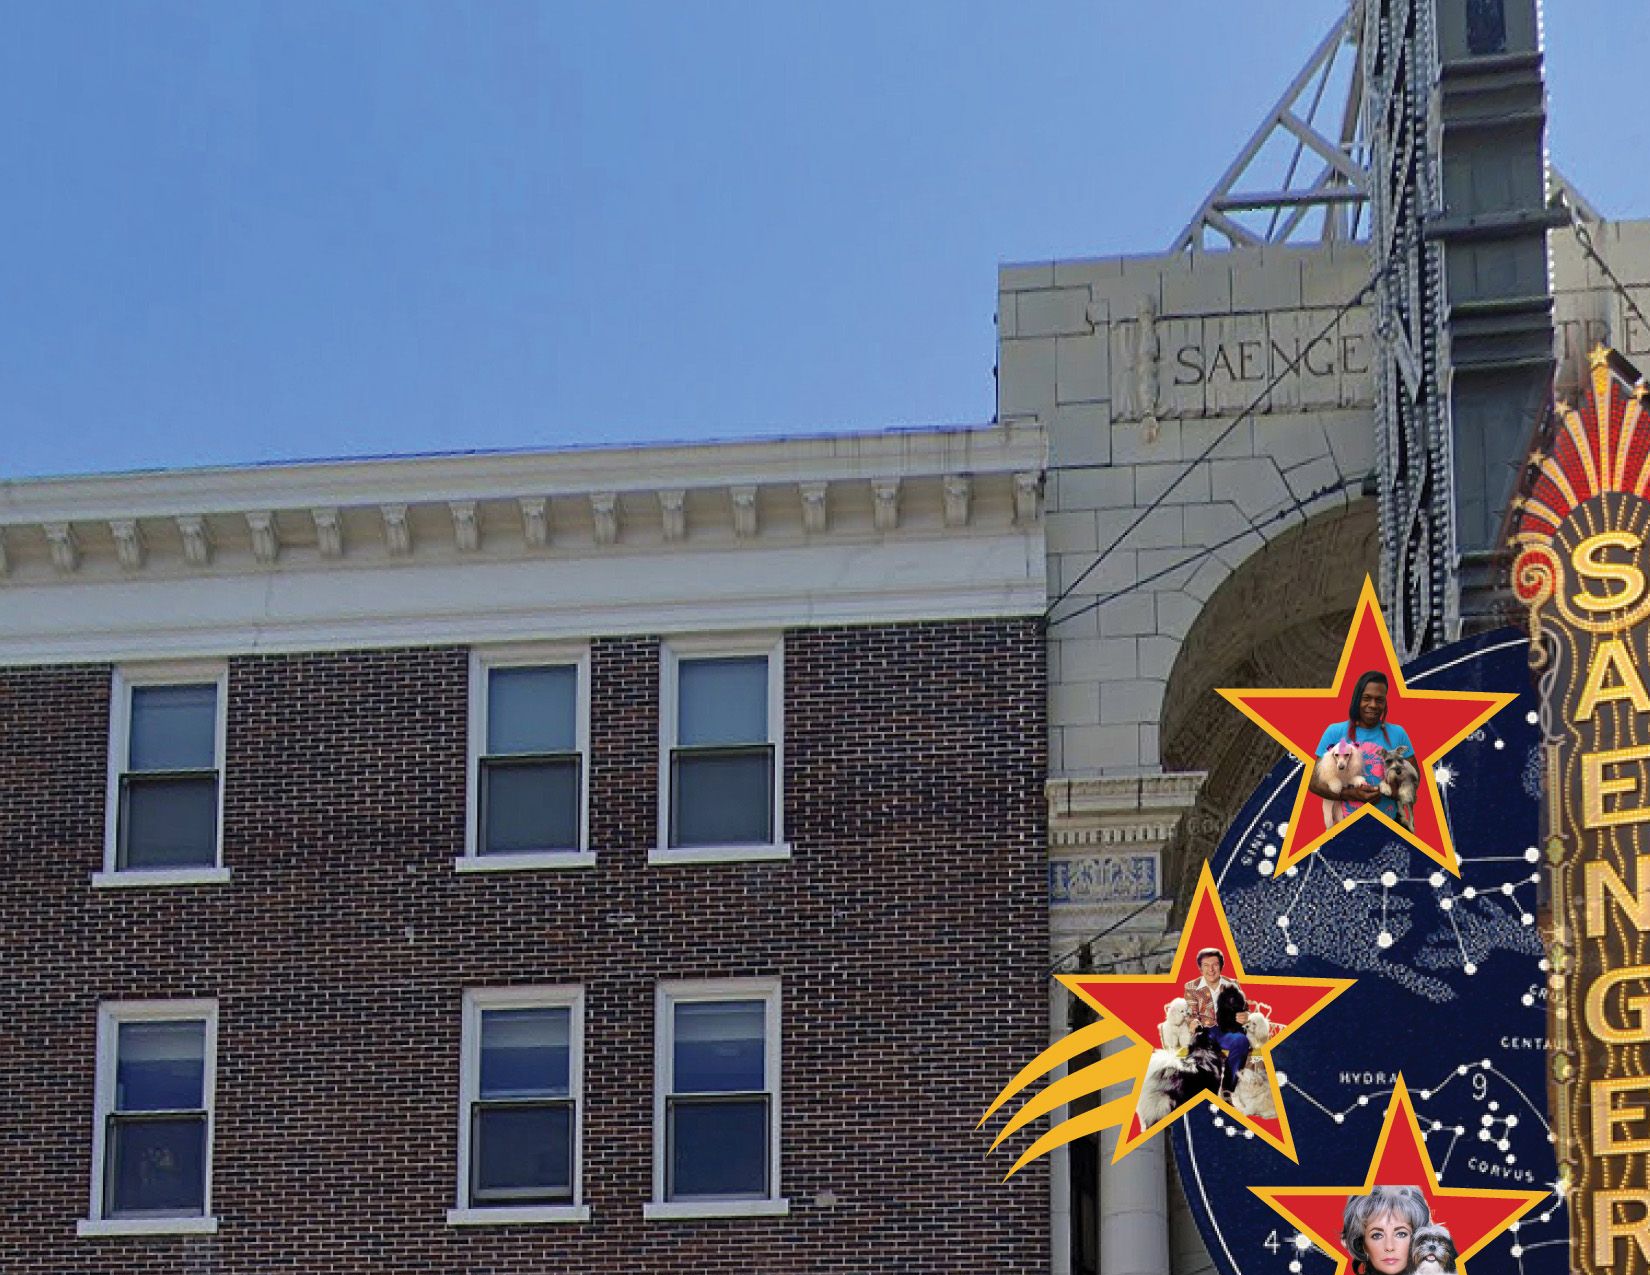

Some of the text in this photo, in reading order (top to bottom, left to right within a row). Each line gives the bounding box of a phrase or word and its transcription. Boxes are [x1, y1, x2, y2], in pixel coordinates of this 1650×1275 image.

[1174, 334, 1369, 386] SAENGE
[1472, 1073, 1487, 1100] 9
[1467, 1157, 1535, 1184] CORVUS
[1263, 1228, 1281, 1255] 4
